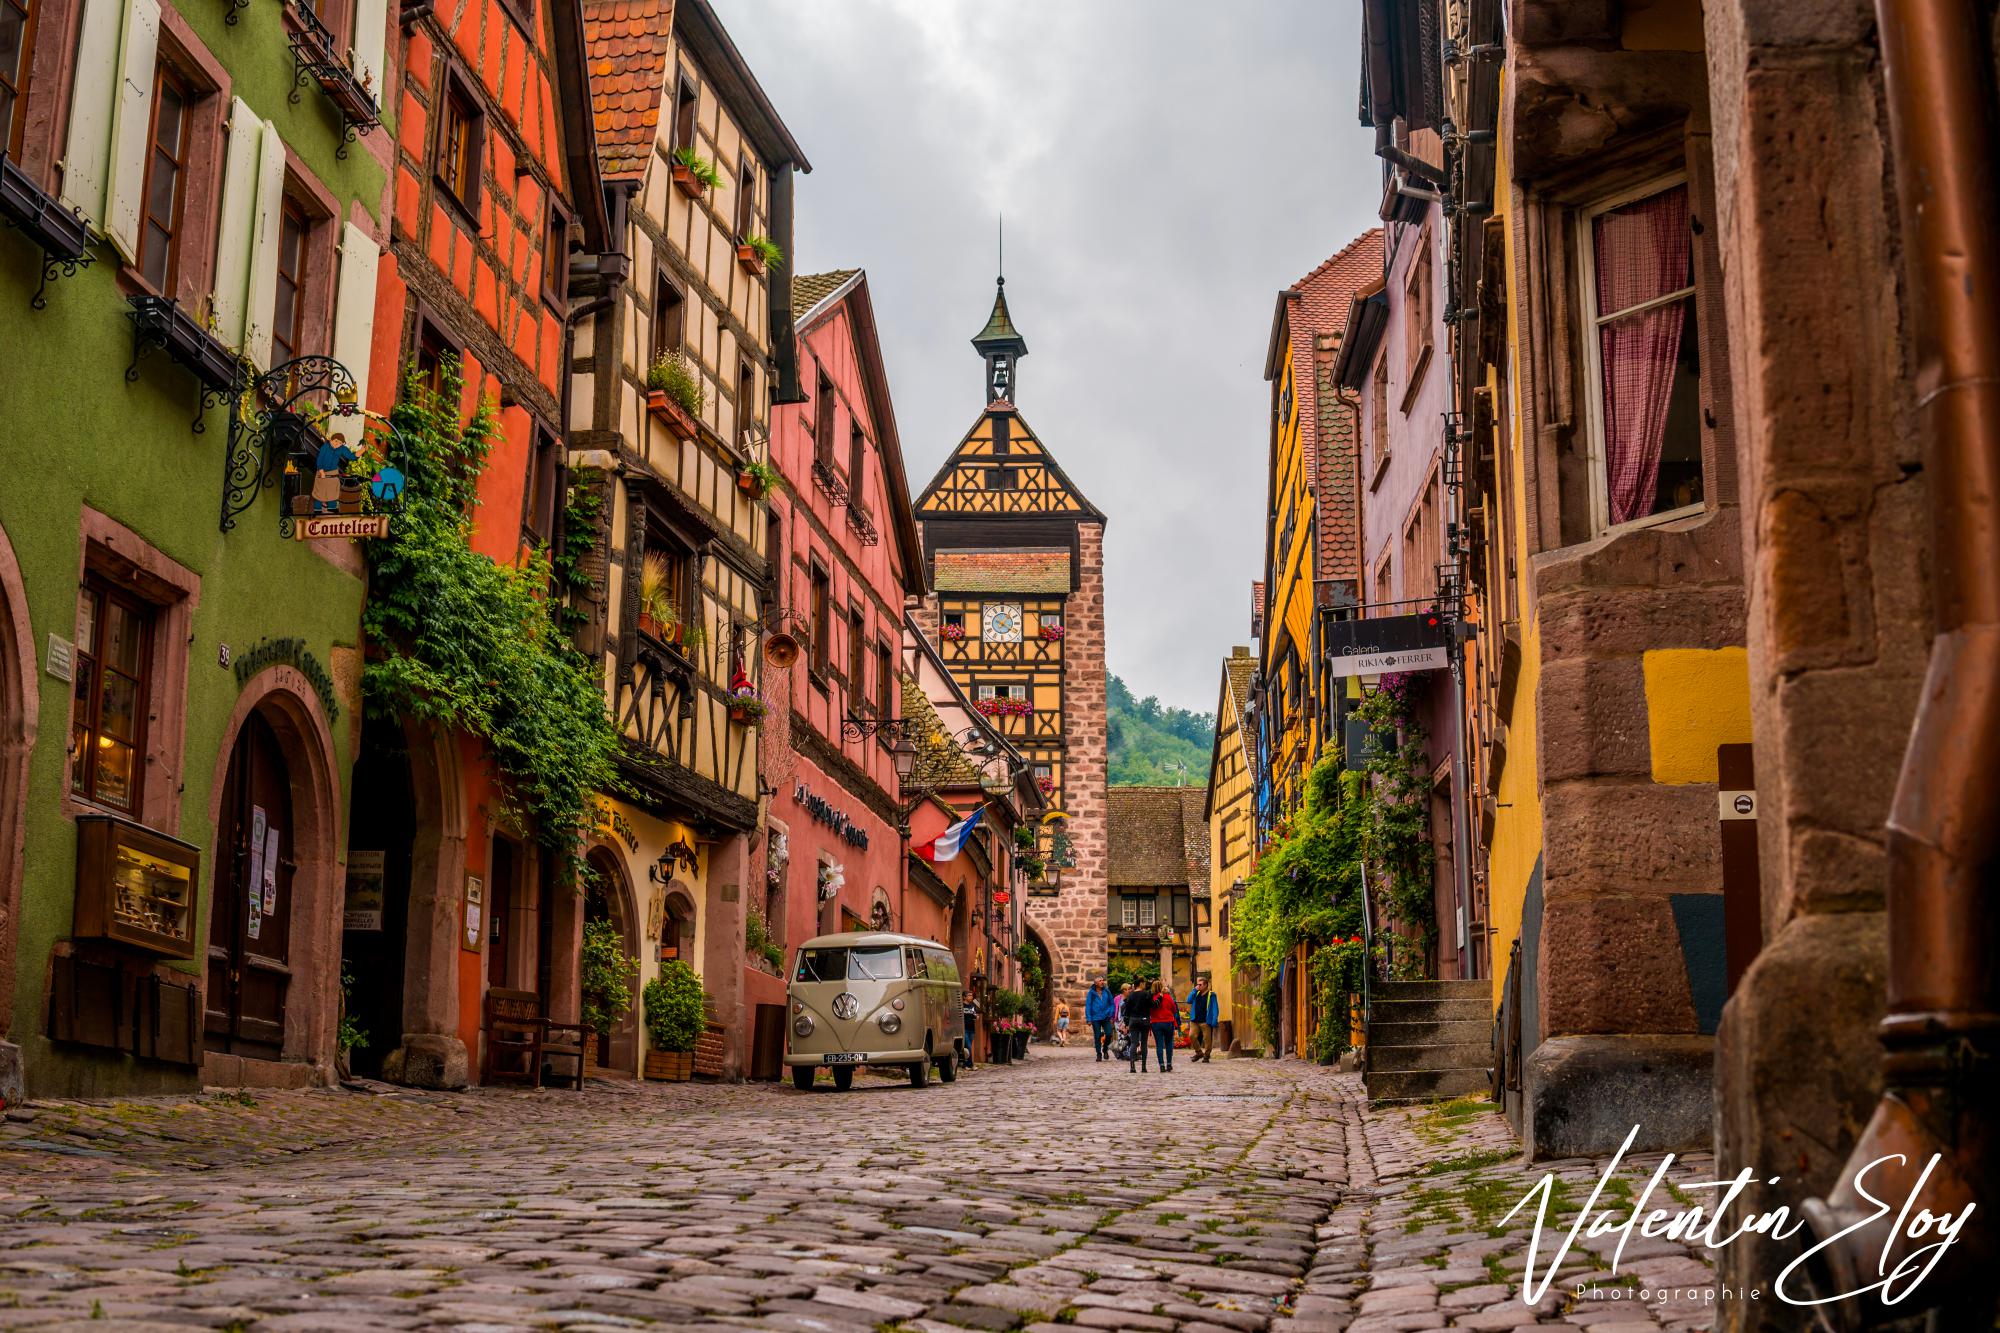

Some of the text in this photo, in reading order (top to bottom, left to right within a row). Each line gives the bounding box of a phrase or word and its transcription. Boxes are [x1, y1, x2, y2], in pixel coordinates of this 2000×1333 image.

[308, 520, 377, 536] Coutelier
[221, 646, 230, 665] 39
[1358, 653, 1433, 668] RIKIA FERRER
